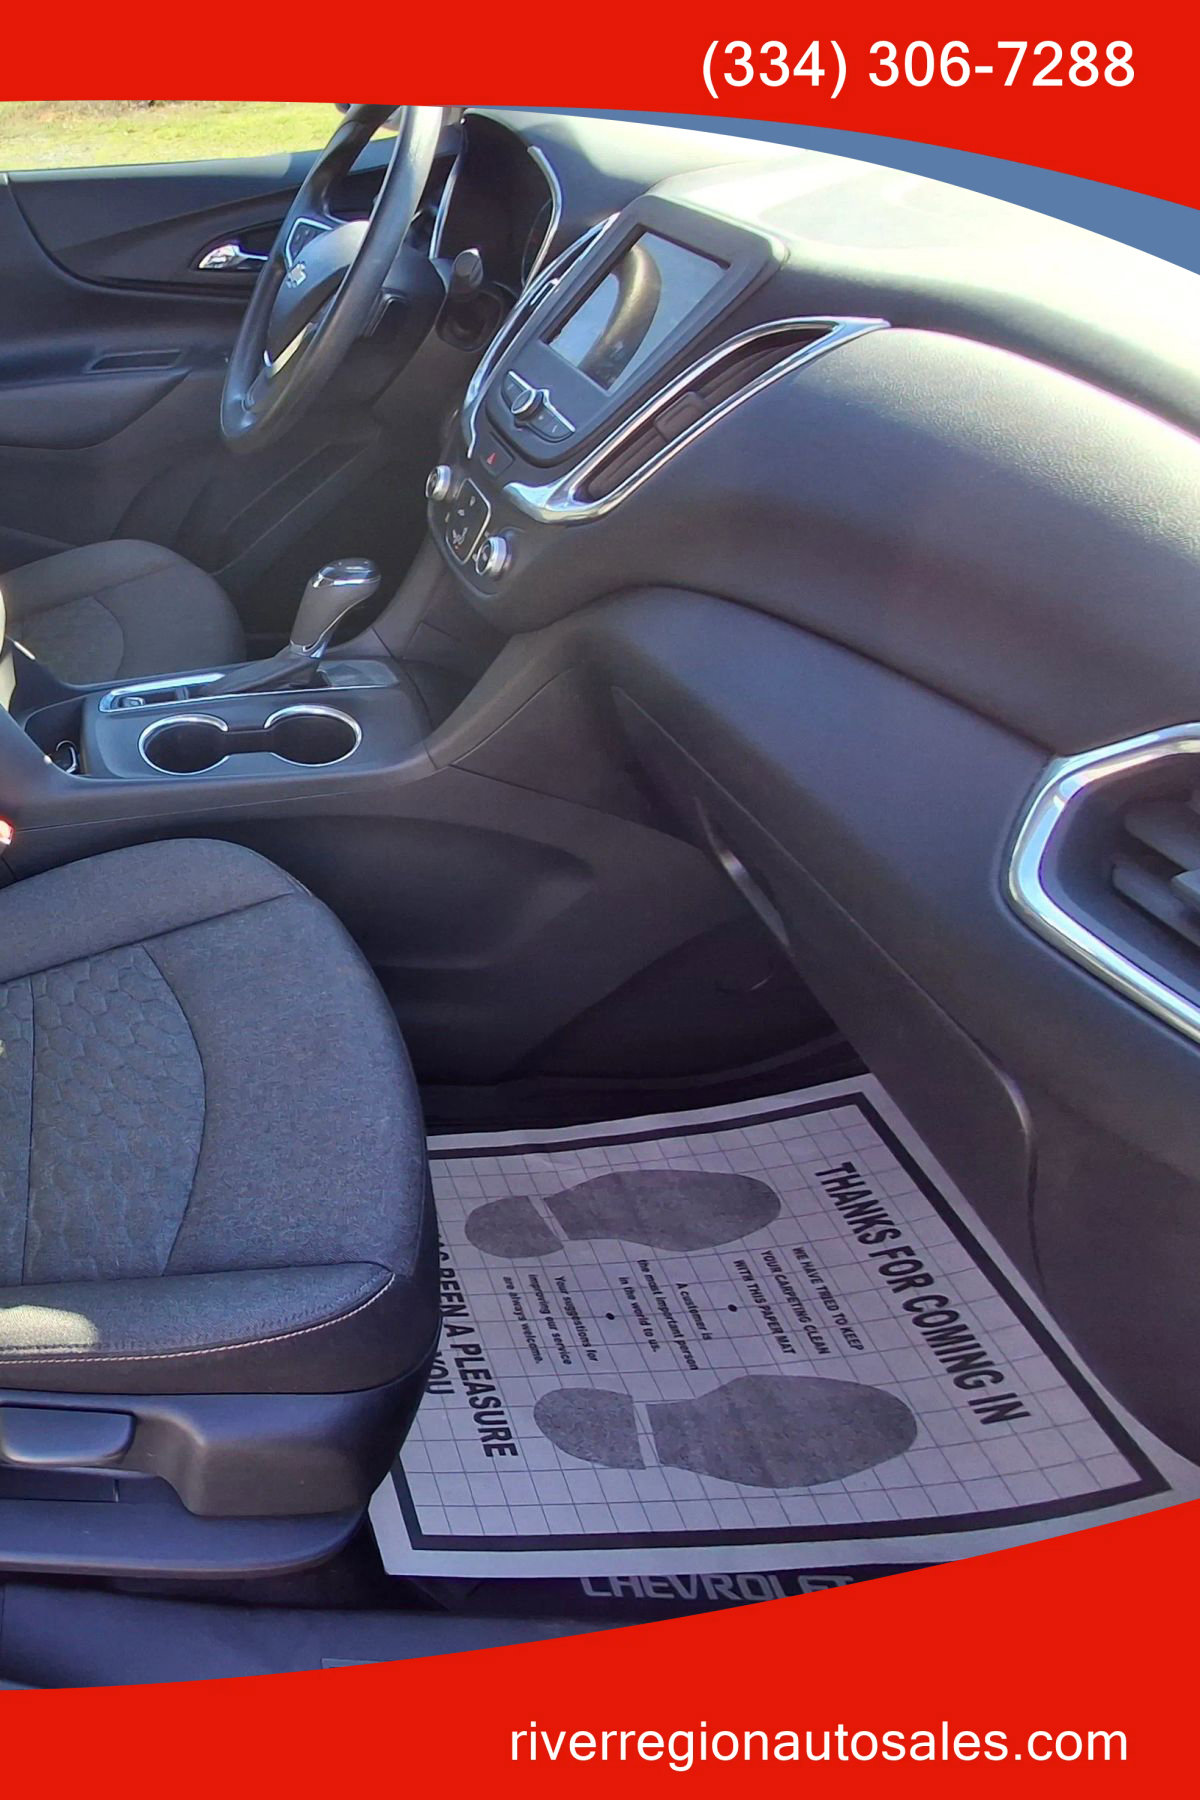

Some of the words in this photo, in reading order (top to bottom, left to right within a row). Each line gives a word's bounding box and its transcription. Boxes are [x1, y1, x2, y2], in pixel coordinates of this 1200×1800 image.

[792, 1246, 809, 1260] WE
[502, 1276, 516, 1290] are
[618, 1276, 630, 1286] in
[800, 1261, 825, 1285] HAVE
[527, 1274, 551, 1315] improving
[623, 1286, 637, 1301] the
[675, 1282, 689, 1290] A
[814, 1161, 902, 1245] THANKS
[868, 1245, 935, 1294] FOR
[902, 1294, 1005, 1391] COMING
[968, 1392, 1032, 1425] IN
[815, 1285, 840, 1311] TRIED
[508, 1291, 528, 1321] always
[631, 1302, 652, 1326] world
[680, 1290, 708, 1331] customer
[733, 1259, 756, 1282] WITH
[746, 1283, 768, 1304] THIS
[758, 1304, 785, 1335] PAPER
[774, 1335, 797, 1355] MAT
[760, 1249, 783, 1273] YOUR
[774, 1274, 813, 1323] CARPETING
[803, 1324, 831, 1355] CLEAN
[545, 1316, 559, 1331] our
[554, 1275, 569, 1295] Your
[562, 1296, 592, 1347] suggestions
[585, 1349, 600, 1362] for
[637, 1259, 651, 1273] the
[644, 1274, 664, 1295] most
[655, 1296, 685, 1338] important
[672, 1340, 699, 1371] person
[832, 1312, 848, 1326] TO
[443, 1323, 476, 1338] A
[642, 1328, 655, 1338] to
[701, 1332, 713, 1341] is
[840, 1327, 865, 1351] KEEP
[551, 1332, 573, 1365] service
[449, 1343, 520, 1458] PLEASURE
